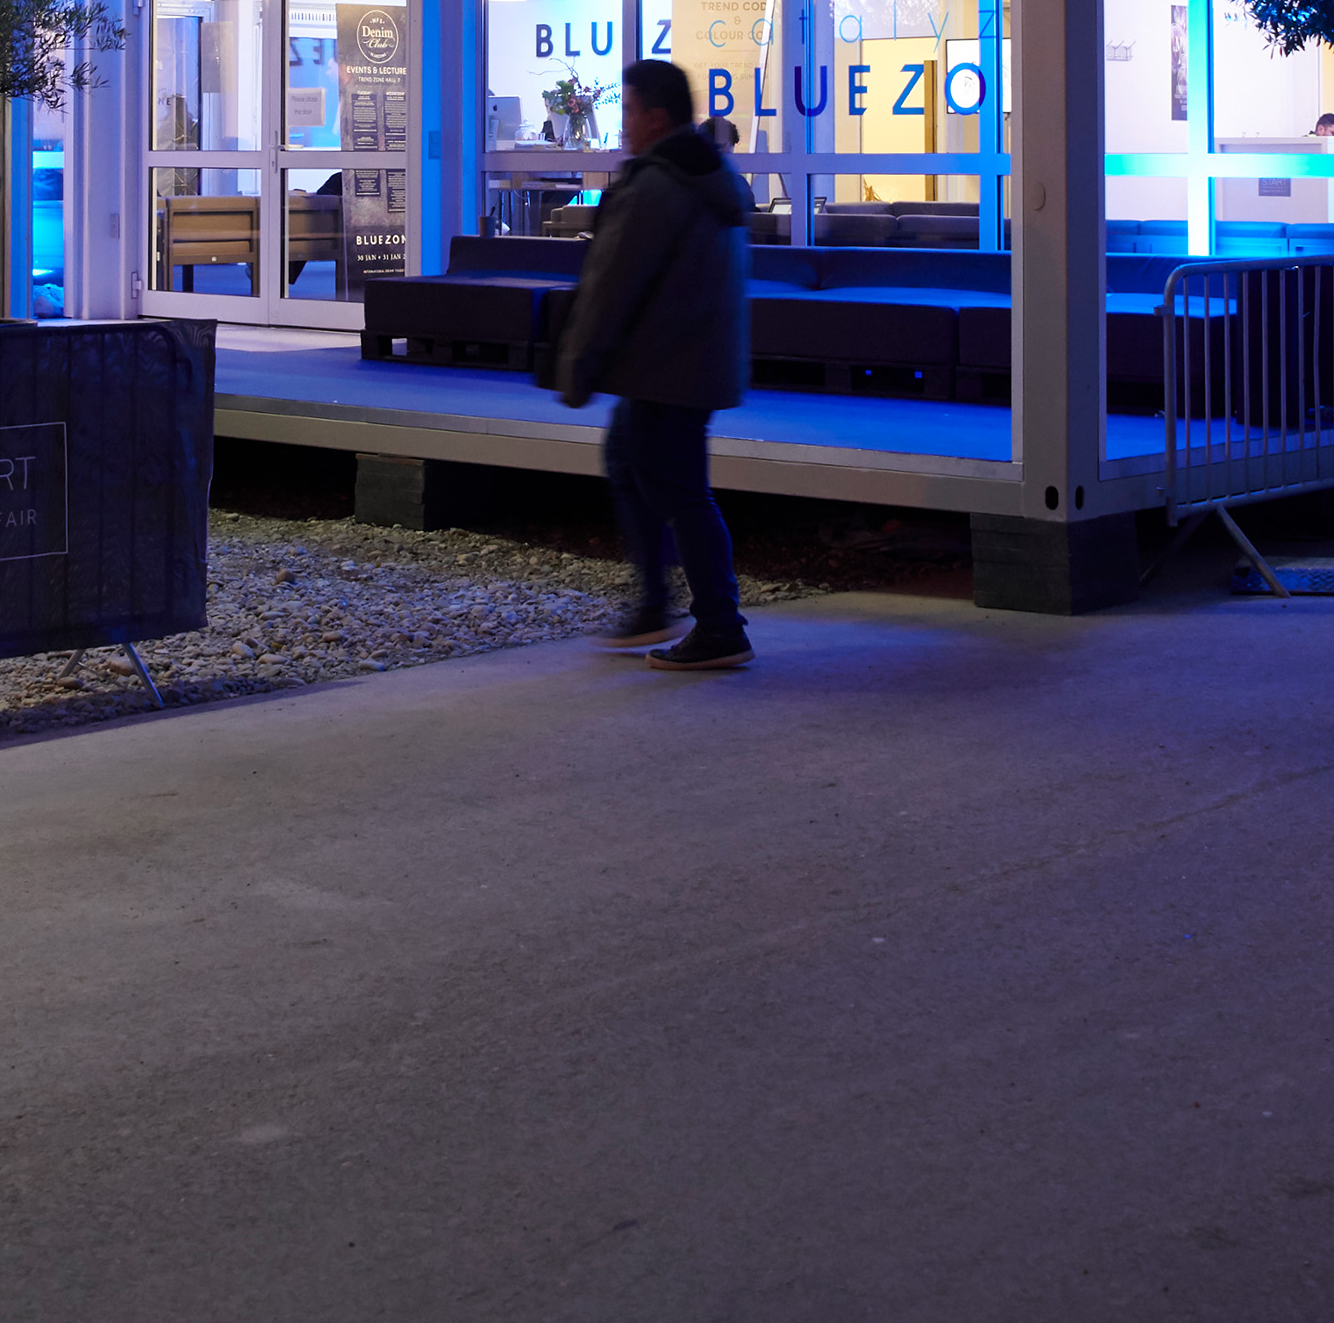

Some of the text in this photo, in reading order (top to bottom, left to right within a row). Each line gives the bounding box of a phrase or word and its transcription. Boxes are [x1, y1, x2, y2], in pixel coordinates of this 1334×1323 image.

[701, 2, 739, 11] TREND
[361, 25, 393, 38] Denim
[696, 30, 743, 40] COLOUR
[346, 65, 372, 74] EVENTS
[373, 66, 378, 74] &
